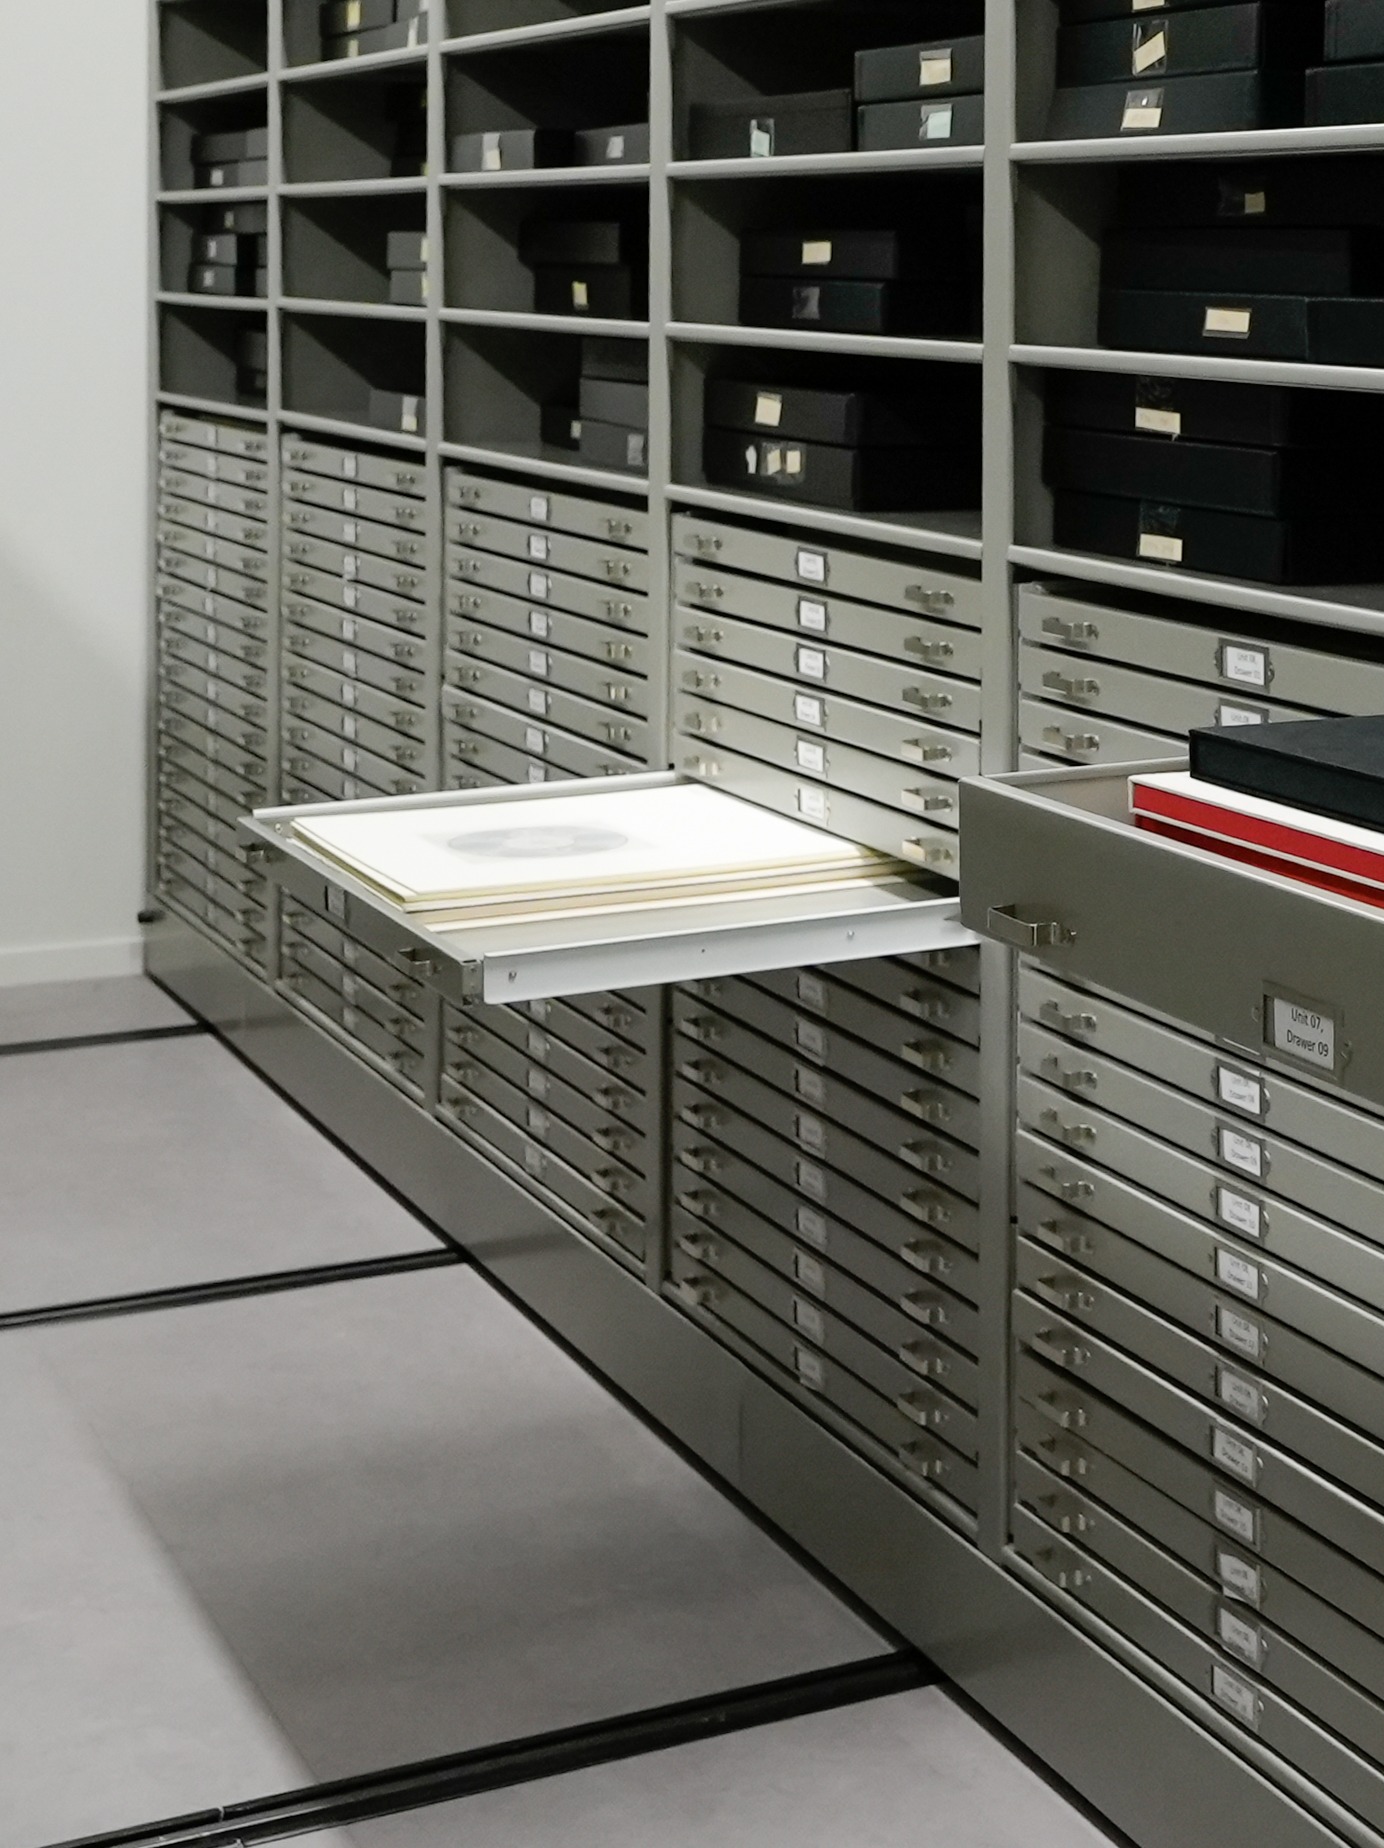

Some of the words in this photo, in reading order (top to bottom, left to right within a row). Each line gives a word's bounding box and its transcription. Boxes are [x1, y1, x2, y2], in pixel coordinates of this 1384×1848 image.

[1291, 1007, 1309, 1026] Unit
[1310, 1014, 1324, 1034] 07,
[1286, 1029, 1316, 1052] Drawer
[1317, 1041, 1329, 1057] 09
